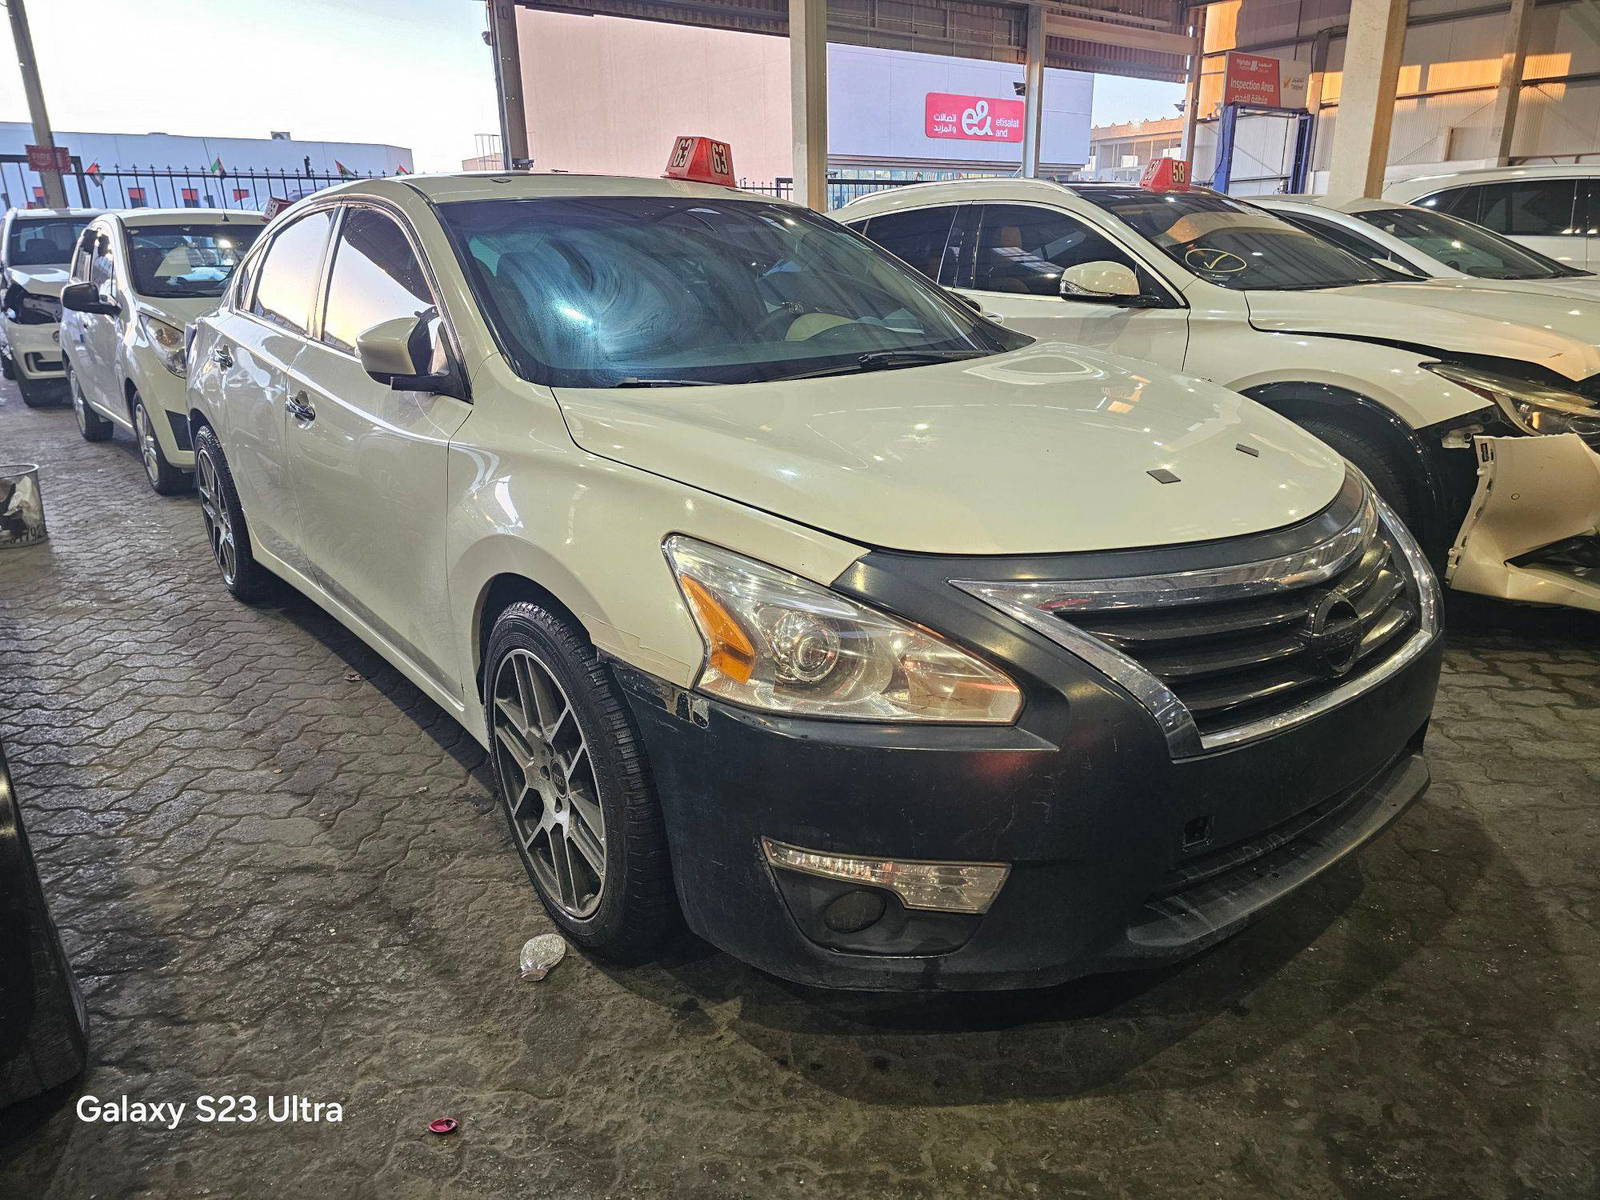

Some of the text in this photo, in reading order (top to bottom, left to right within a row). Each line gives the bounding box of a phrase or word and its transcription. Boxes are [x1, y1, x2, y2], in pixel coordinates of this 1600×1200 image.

[1230, 76, 1260, 91] Inspection
[1261, 80, 1275, 93] Area
[995, 117, 1019, 128] etisalat
[995, 129, 1008, 138] and
[672, 138, 693, 167] 63
[711, 142, 729, 175] 63
[1171, 160, 1185, 183] 58
